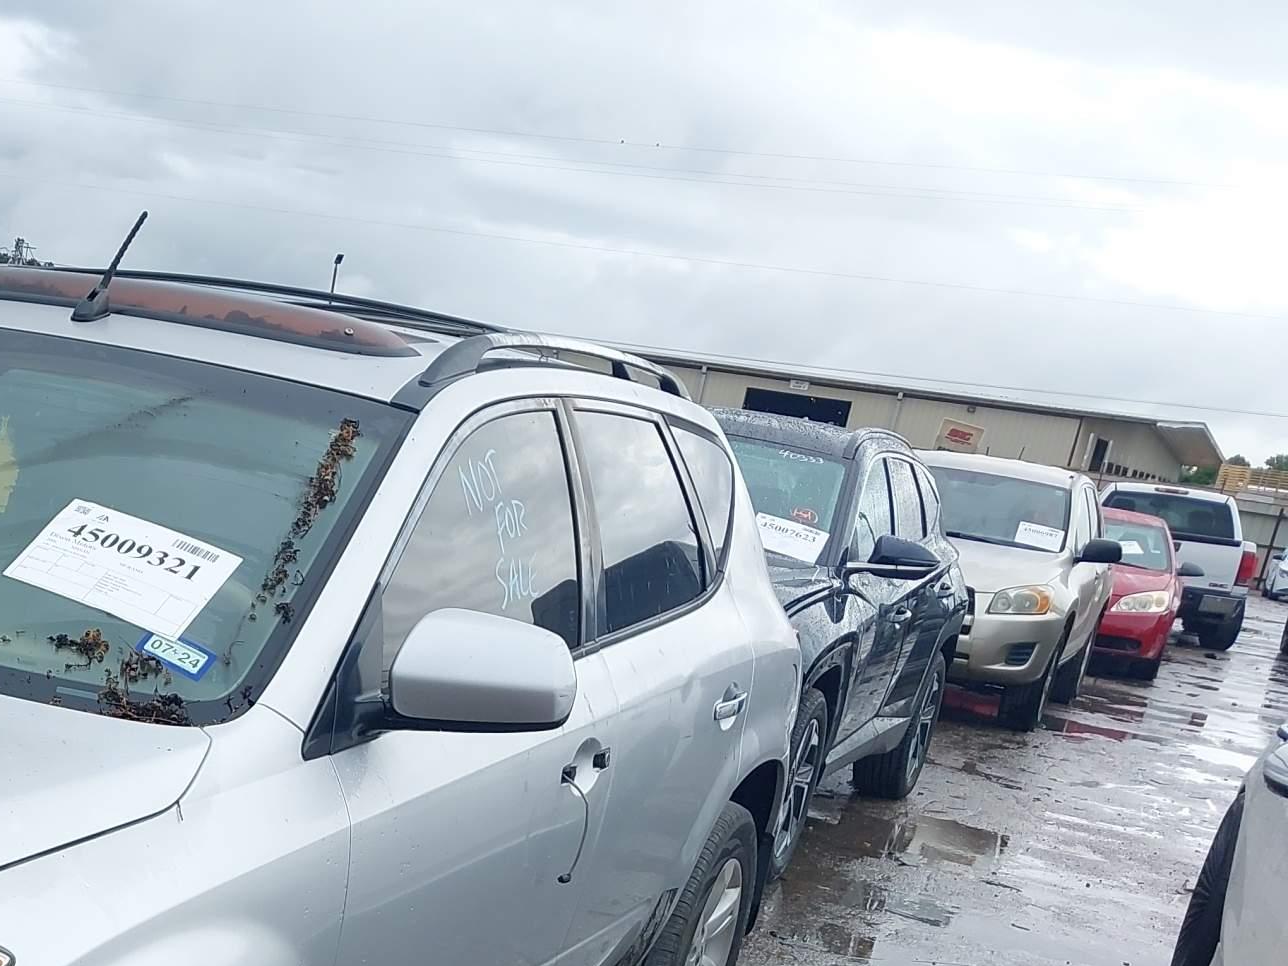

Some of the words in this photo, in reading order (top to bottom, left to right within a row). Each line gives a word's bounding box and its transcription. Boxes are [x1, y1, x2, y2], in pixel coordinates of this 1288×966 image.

[458, 448, 503, 519] NOT
[66, 523, 202, 581] 45009321
[494, 499, 529, 554] FOR
[495, 553, 540, 611] SALE
